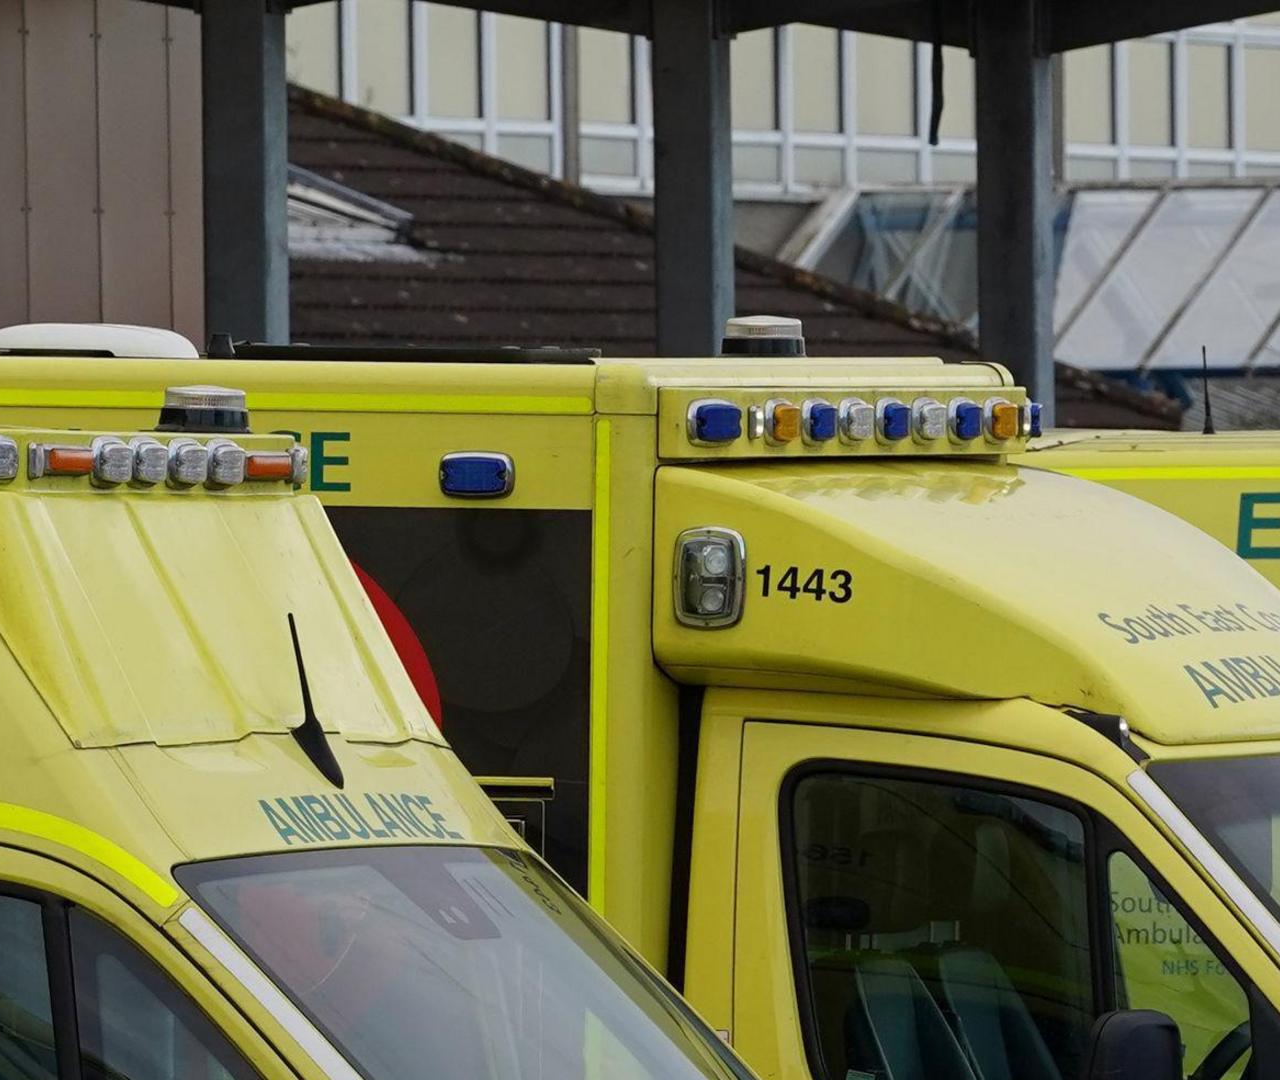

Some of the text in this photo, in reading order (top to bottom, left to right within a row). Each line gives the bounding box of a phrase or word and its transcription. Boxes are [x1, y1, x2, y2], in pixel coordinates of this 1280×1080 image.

[756, 564, 852, 604] 1443
[1097, 604, 1200, 644] South
[258, 793, 465, 845] AMBULANCE
